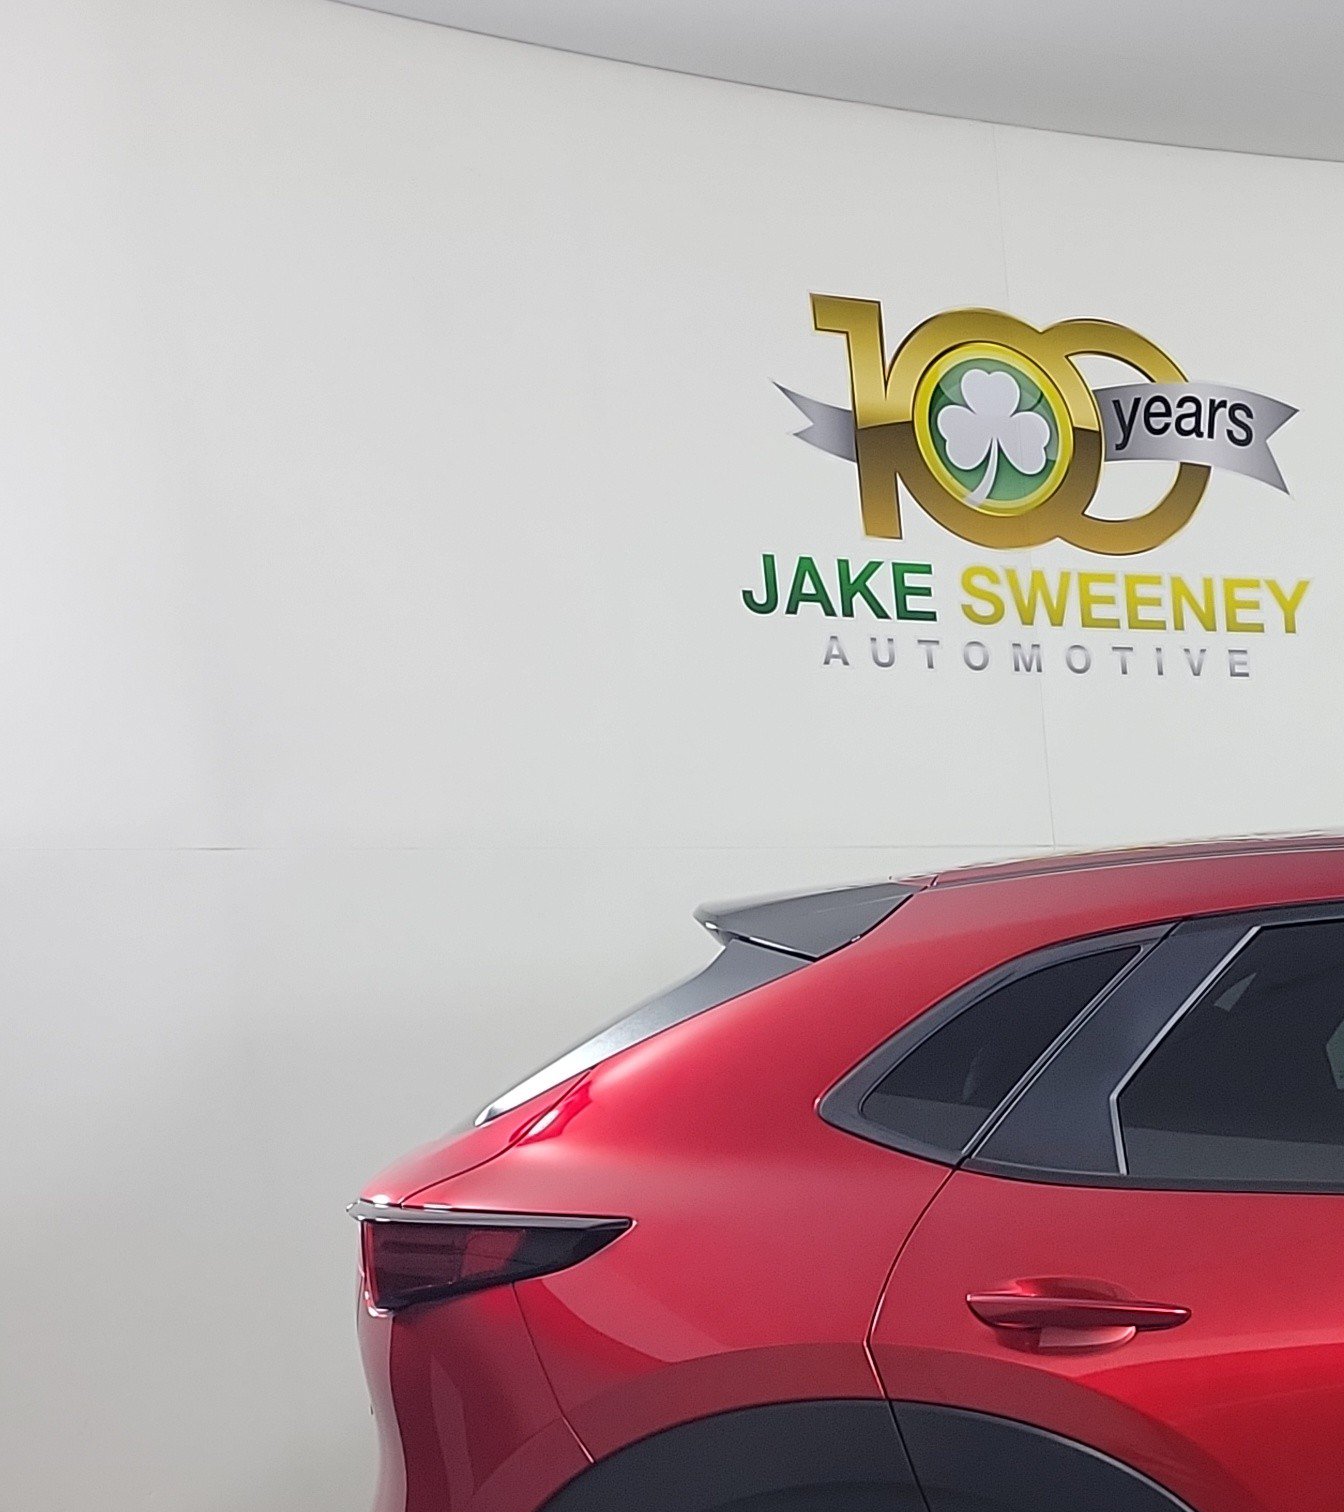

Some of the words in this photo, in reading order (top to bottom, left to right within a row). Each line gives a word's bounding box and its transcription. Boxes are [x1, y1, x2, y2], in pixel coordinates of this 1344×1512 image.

[809, 293, 1212, 556] 100
[1112, 394, 1255, 451] years
[741, 553, 938, 622] JAKE
[960, 565, 1312, 635] SWEENEY
[823, 635, 1252, 679] AUTOMOTIVE
